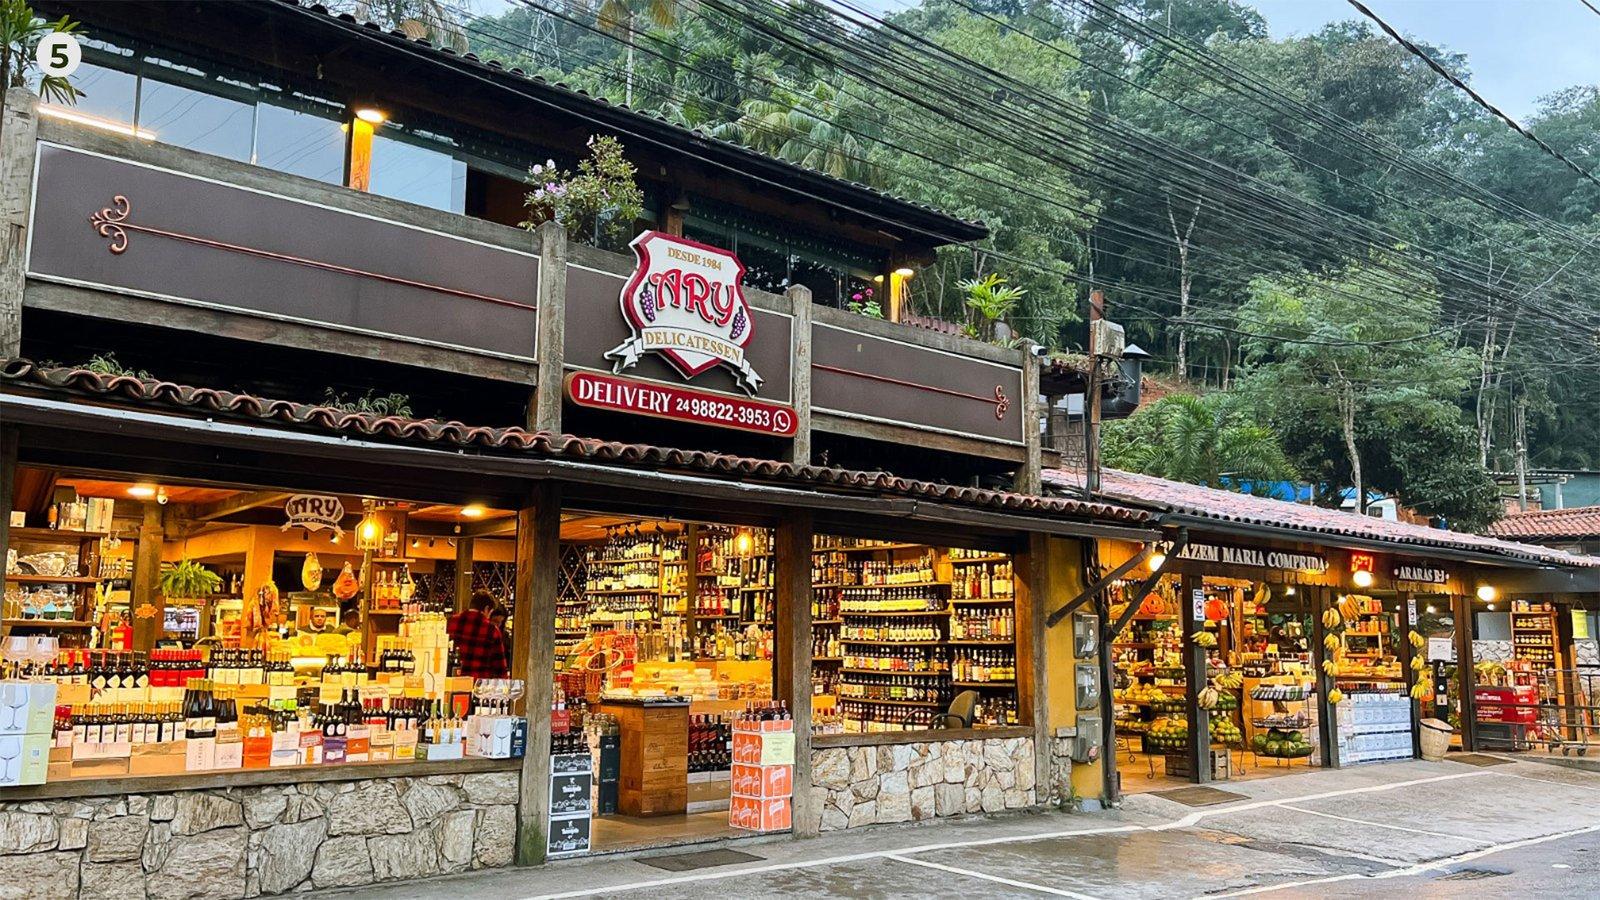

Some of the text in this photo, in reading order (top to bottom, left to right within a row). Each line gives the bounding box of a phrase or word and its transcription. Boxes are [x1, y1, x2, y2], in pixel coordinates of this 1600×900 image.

[667, 247, 722, 271] DESDE 1984
[650, 269, 735, 326] ARY
[645, 331, 741, 362] DELICATESSEN
[578, 378, 770, 426] DELIVERY 24 98822-3953
[292, 497, 337, 518] ARY
[1222, 547, 1265, 567] MARIA
[1267, 552, 1326, 572] COMPRIDA
[1399, 566, 1433, 581] ARARAS
